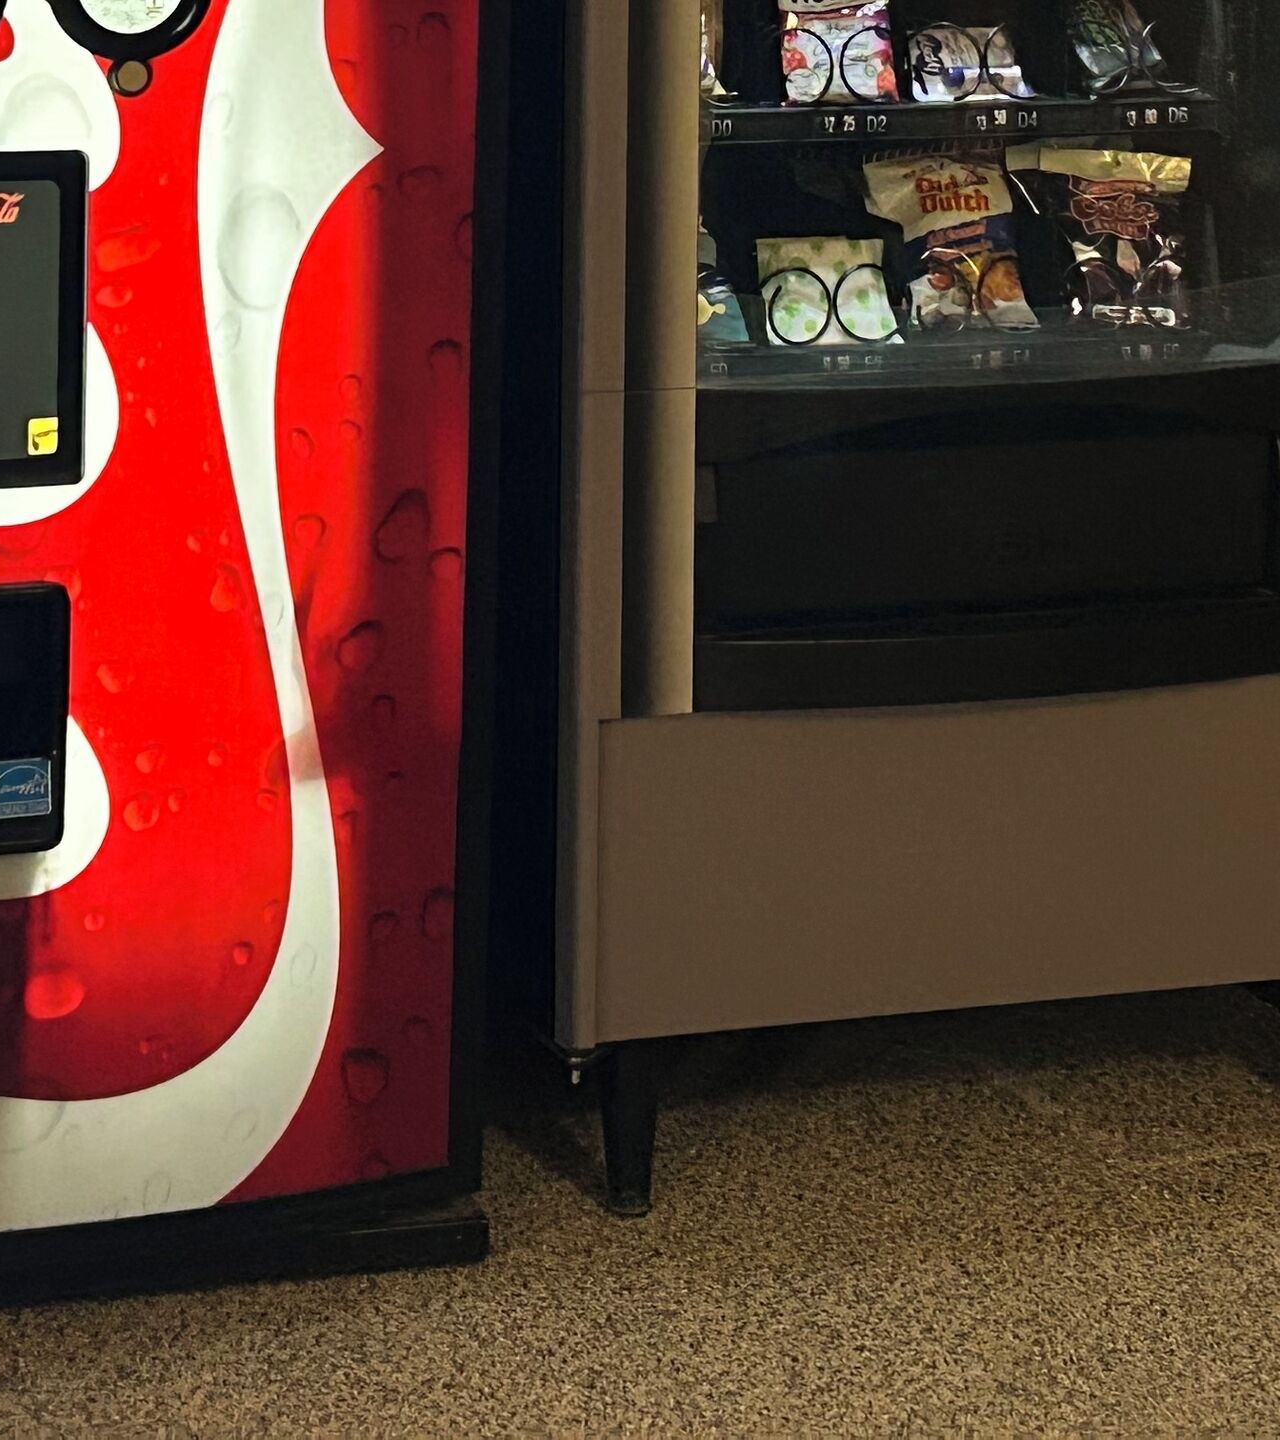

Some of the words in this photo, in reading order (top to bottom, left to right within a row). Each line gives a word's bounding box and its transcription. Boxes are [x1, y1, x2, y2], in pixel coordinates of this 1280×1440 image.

[867, 115, 887, 133] D2
[1018, 111, 1038, 129] D4
[1168, 107, 1189, 123] D6
[712, 119, 732, 137] D0
[921, 188, 990, 214] Dutch
